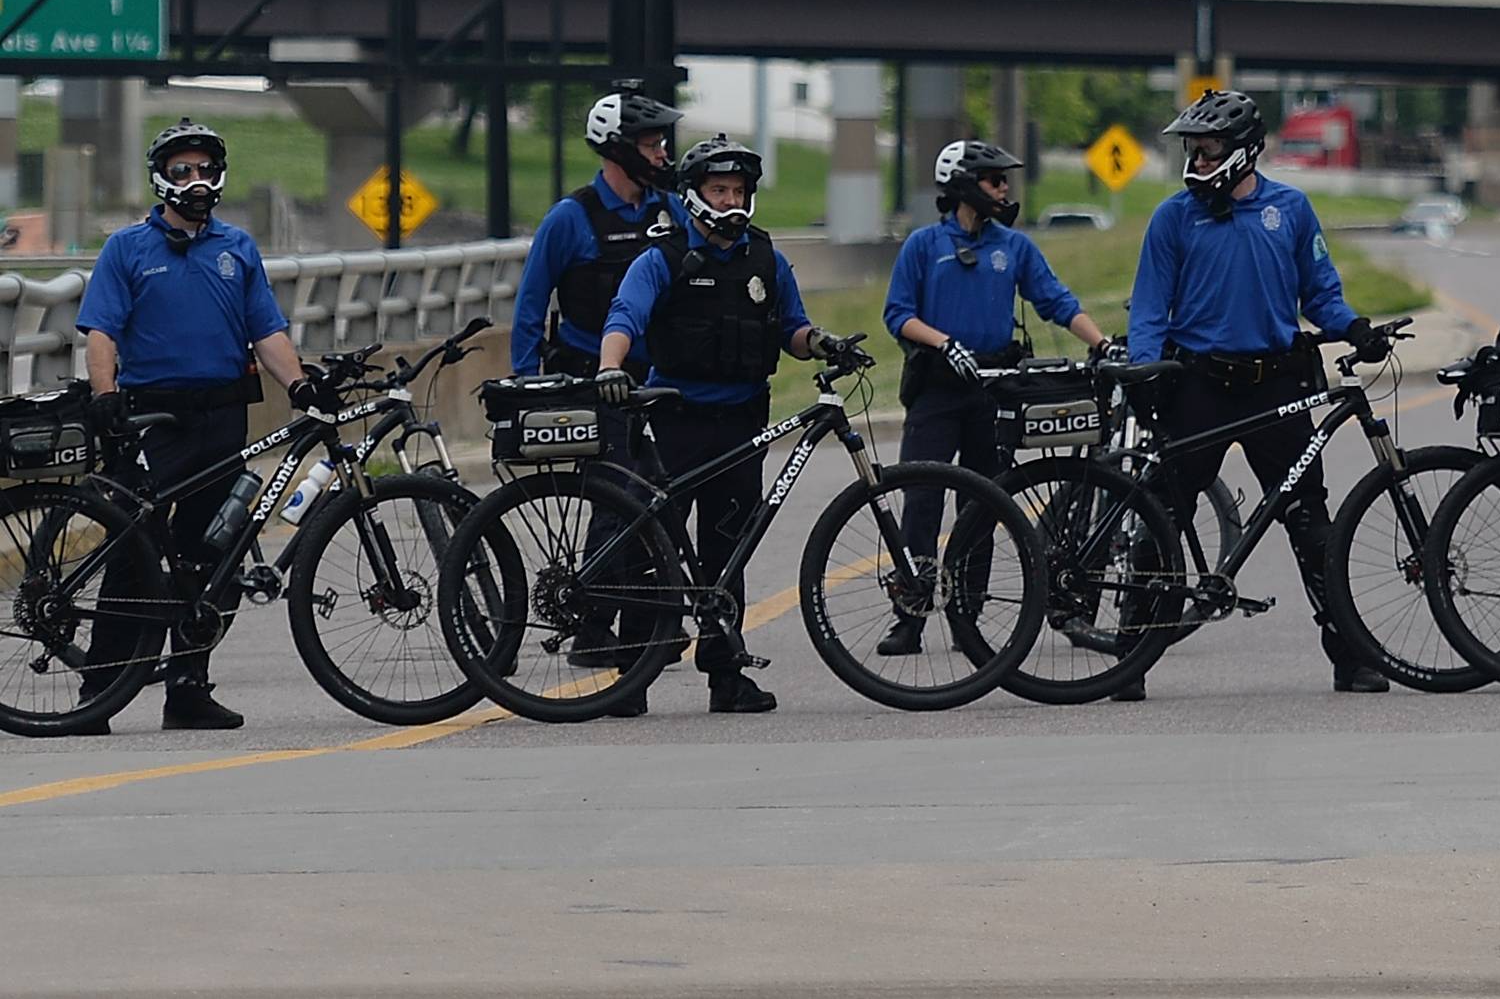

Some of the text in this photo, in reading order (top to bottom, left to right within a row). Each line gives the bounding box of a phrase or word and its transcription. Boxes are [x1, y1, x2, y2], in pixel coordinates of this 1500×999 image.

[51, 30, 99, 52] Ave
[337, 403, 377, 422] OLICE
[1278, 392, 1329, 418] POLICE
[523, 424, 600, 443] POLICE
[752, 415, 802, 448] POLICE
[1025, 413, 1101, 435] POLICE
[240, 427, 291, 460] POLICE
[768, 439, 814, 506] volcanic
[1280, 429, 1329, 493] volcanic
[252, 454, 299, 522] volcanic
